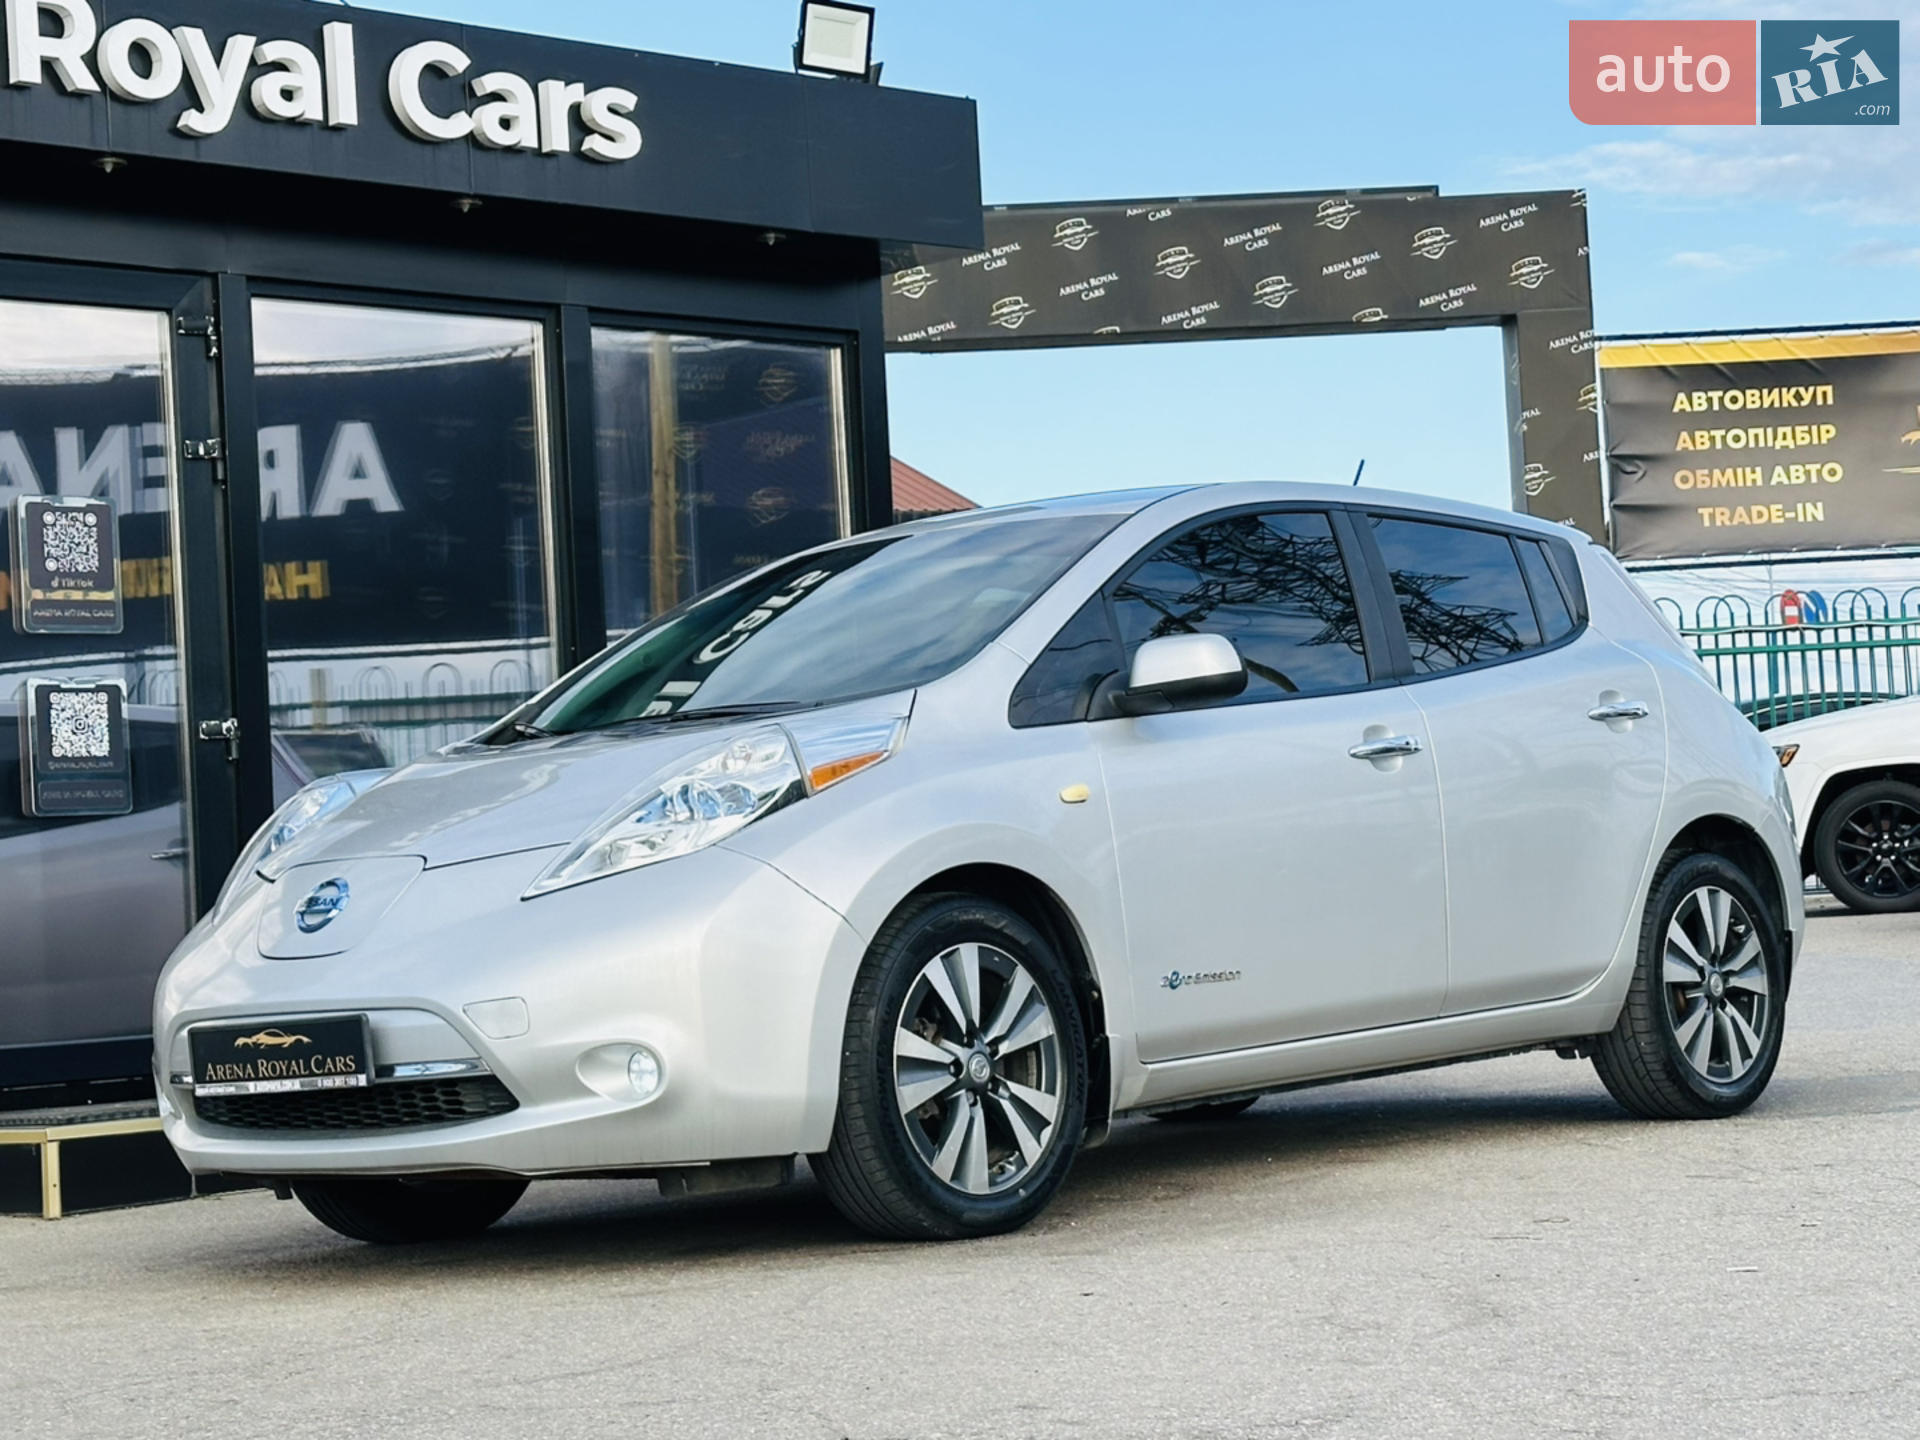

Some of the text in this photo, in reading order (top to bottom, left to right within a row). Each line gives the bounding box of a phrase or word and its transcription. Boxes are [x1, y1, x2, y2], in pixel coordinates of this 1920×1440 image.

[5, 0, 643, 163] Royal Cars
[1148, 207, 1172, 221] CARS
[1479, 203, 1538, 228] ARENA ROYAL
[1501, 218, 1525, 232] CARS
[1223, 222, 1282, 247] ARENA ROYAL
[1245, 238, 1269, 251] CARS
[961, 242, 1021, 267] ARENA ROYAL
[983, 257, 1008, 271] CARS
[1322, 251, 1381, 276] ARENA ROYAL
[1059, 272, 1118, 296] ARENA ROYAL
[1343, 266, 1368, 280] CARS
[1081, 287, 1105, 301] CARS
[1418, 283, 1477, 308] ARENA ROYAL
[1440, 298, 1464, 312] CARS
[1161, 301, 1220, 325] ARENA ROYAL
[1183, 316, 1207, 329] CARS
[927, 320, 957, 335] ROYAL
[1549, 335, 1579, 350] ARENA
[1672, 384, 1834, 413] АВТОВИКУП
[1675, 424, 1837, 451] АВТОПІДБІР
[1673, 462, 1843, 490] ОБМІН АВТО
[1698, 502, 1824, 527] TRADE-IN
[206, 1054, 356, 1081] ARENA ROYAL CARS
